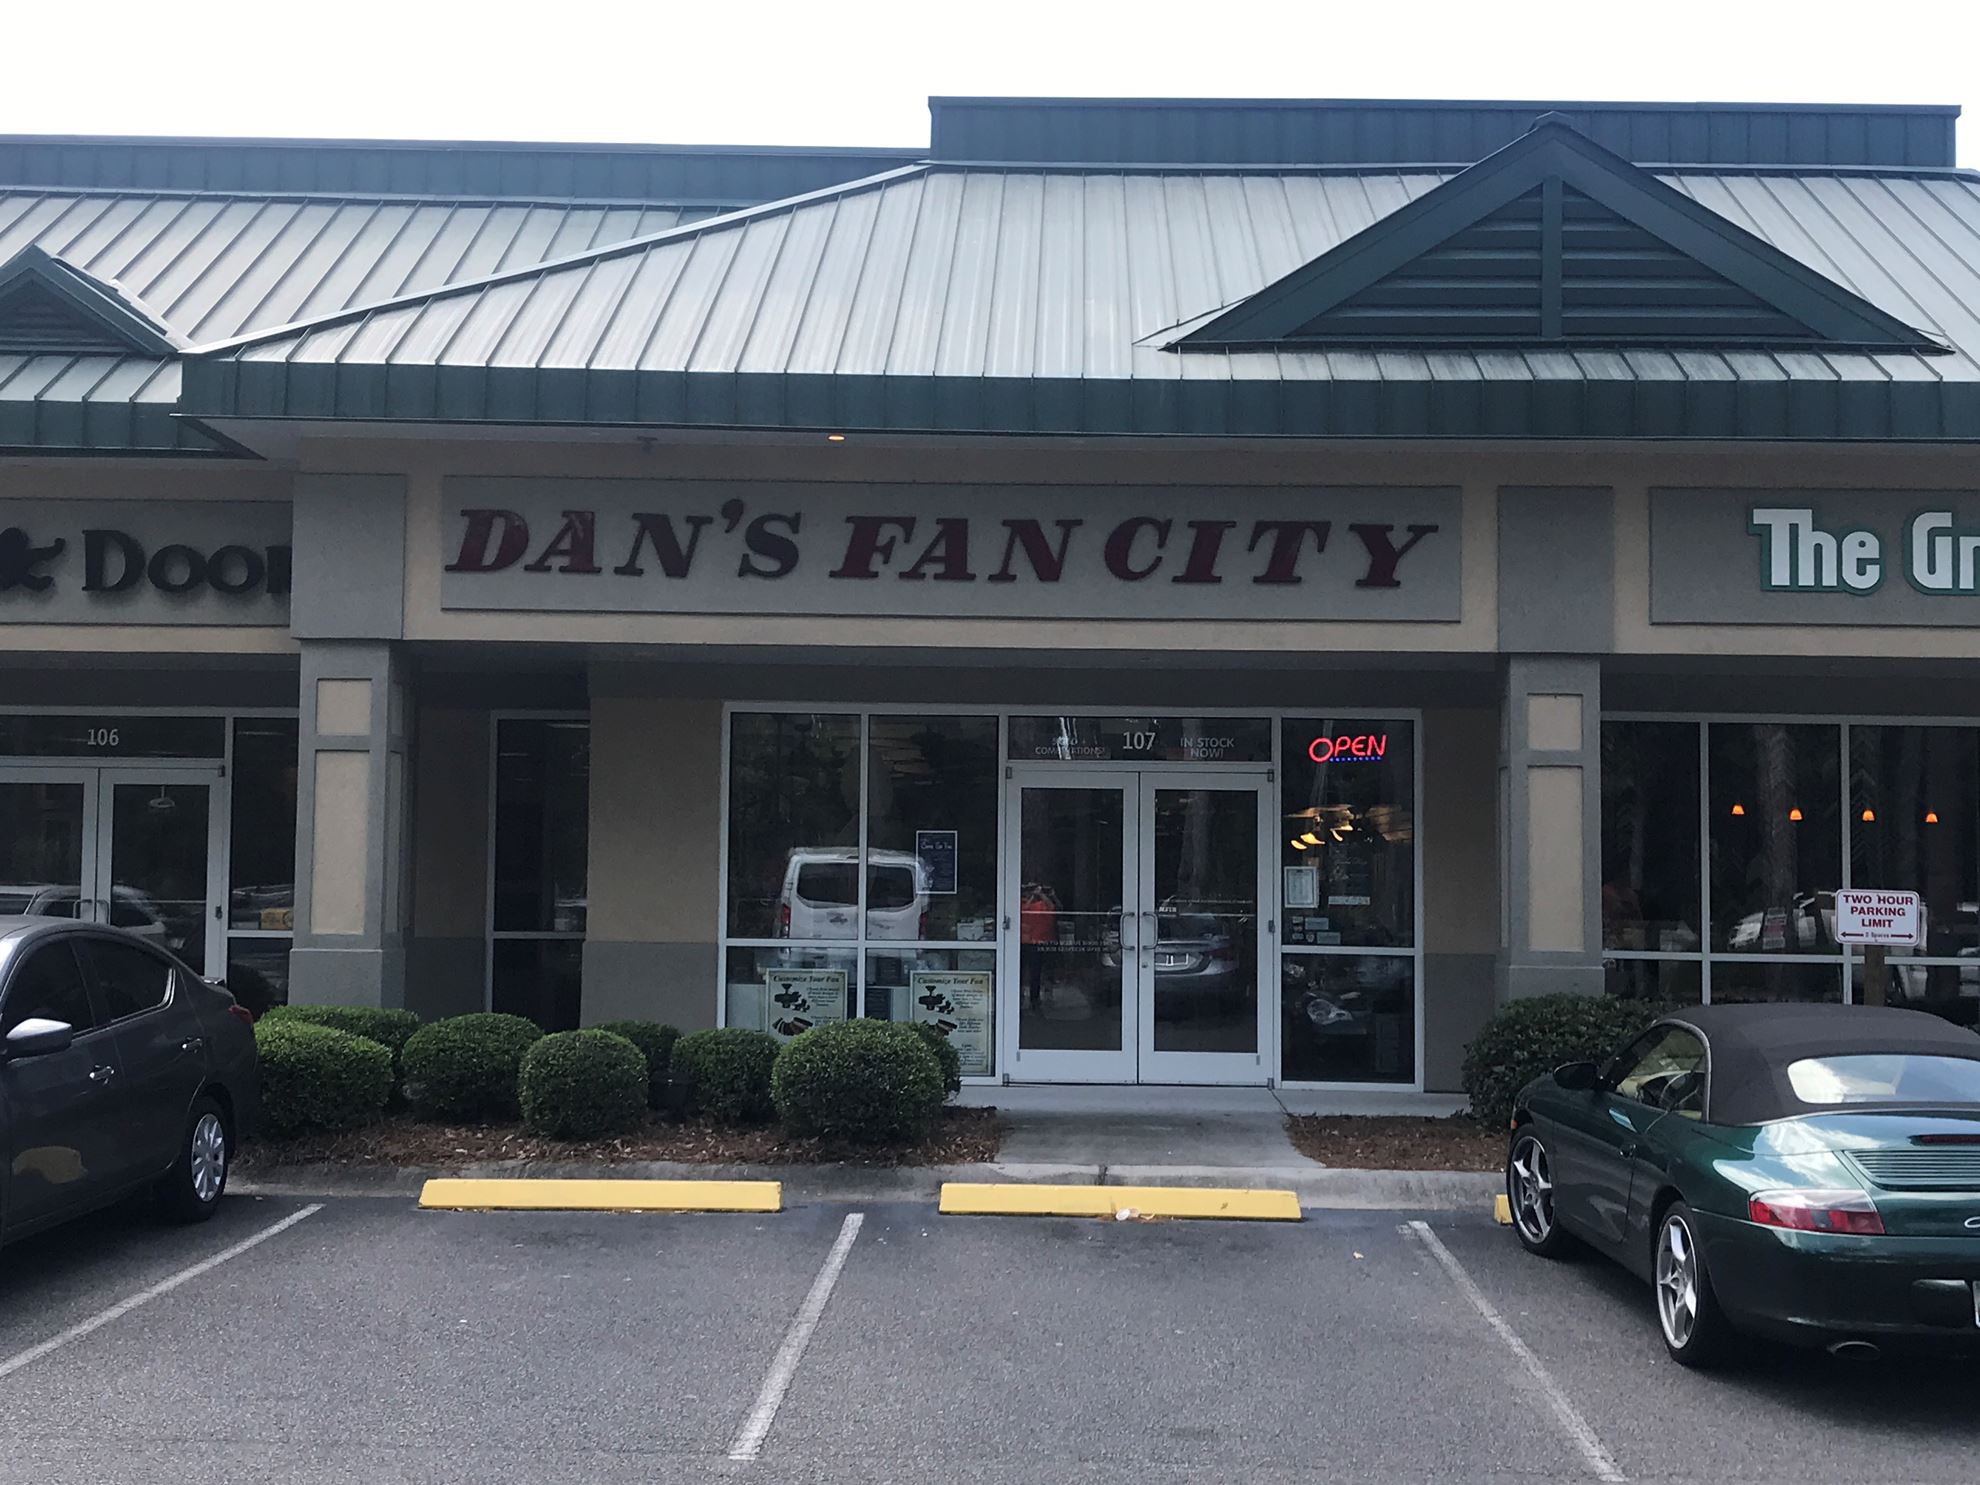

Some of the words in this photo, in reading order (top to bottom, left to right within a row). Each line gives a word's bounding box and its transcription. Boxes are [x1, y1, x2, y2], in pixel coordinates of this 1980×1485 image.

[445, 498, 802, 579] DAN'S
[828, 514, 1084, 583] FAN
[1103, 516, 1440, 587] CITY
[1752, 508, 1880, 590] The
[87, 728, 120, 746] 106
[1122, 731, 1156, 750] 107
[1180, 737, 1193, 748] IN
[1196, 737, 1235, 748] STOCK
[1190, 747, 1224, 758] NOW!
[1308, 734, 1387, 762] OPEN
[1843, 894, 1873, 904] TWO
[1877, 894, 1914, 906] HOUR
[1850, 906, 1906, 917] PARKING
[1861, 918, 1894, 928] LIMIT
